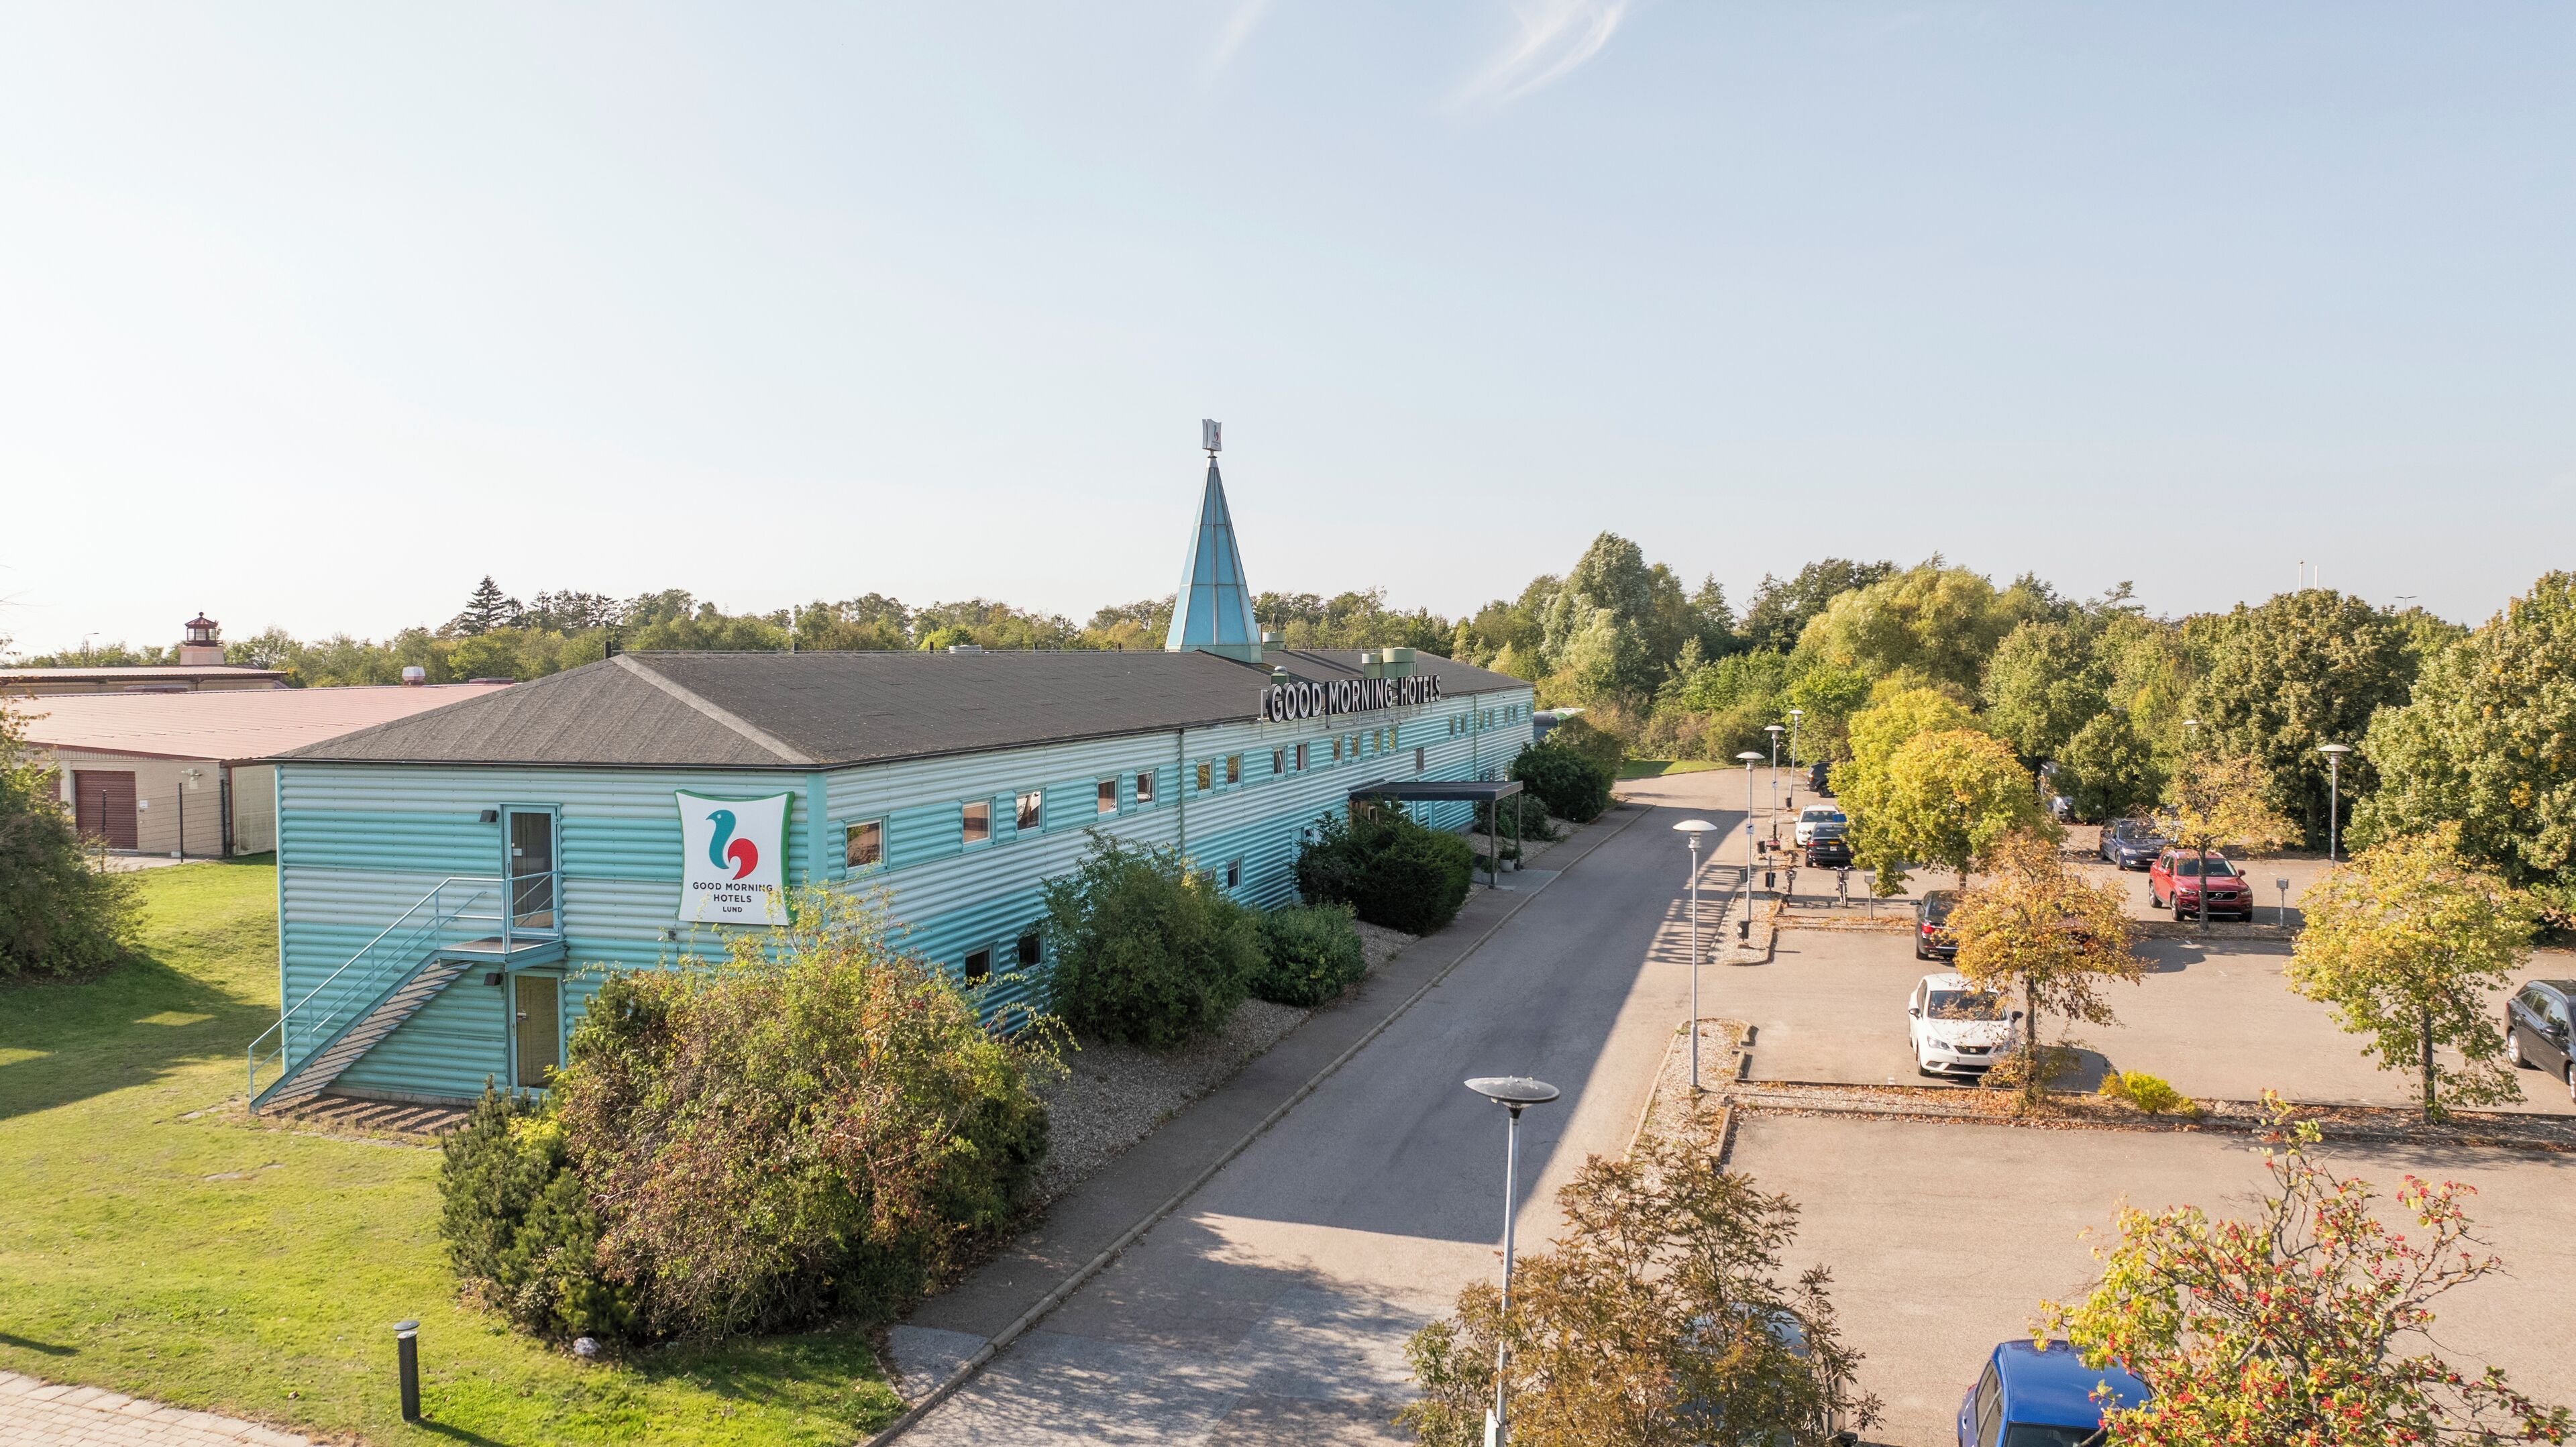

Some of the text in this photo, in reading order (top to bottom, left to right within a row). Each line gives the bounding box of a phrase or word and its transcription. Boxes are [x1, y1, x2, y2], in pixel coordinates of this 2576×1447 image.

[1269, 674, 1441, 723] GOOD MORNING HOTELS
[693, 882, 773, 892] GOOD MORNING
[714, 894, 751, 902] HOTELS
